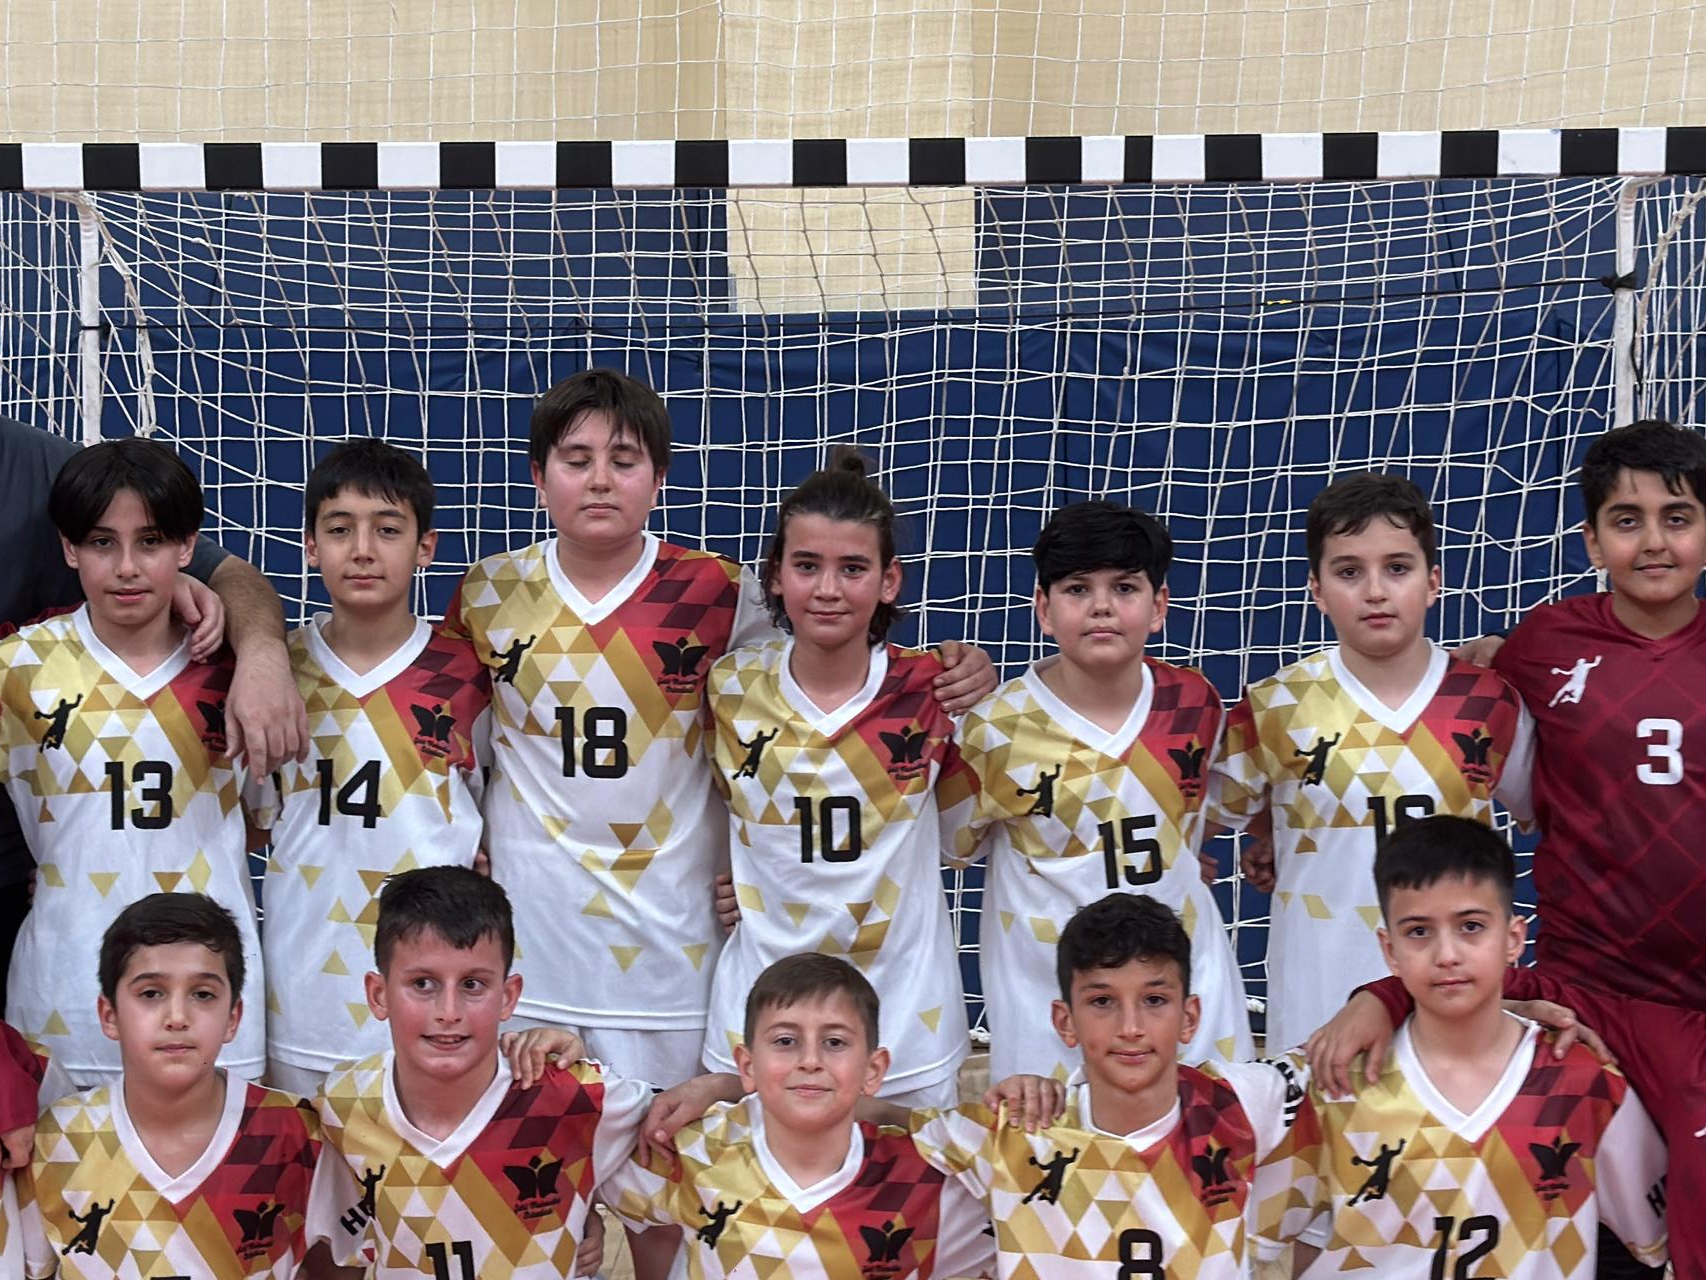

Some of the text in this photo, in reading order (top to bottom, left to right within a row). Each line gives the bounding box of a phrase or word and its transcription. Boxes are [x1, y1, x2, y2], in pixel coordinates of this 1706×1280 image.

[555, 706, 628, 779] 18
[1636, 717, 1684, 786] 3
[104, 760, 173, 831] 13
[316, 758, 382, 829] 14
[794, 795, 862, 864] 10
[1098, 813, 1163, 889] 15
